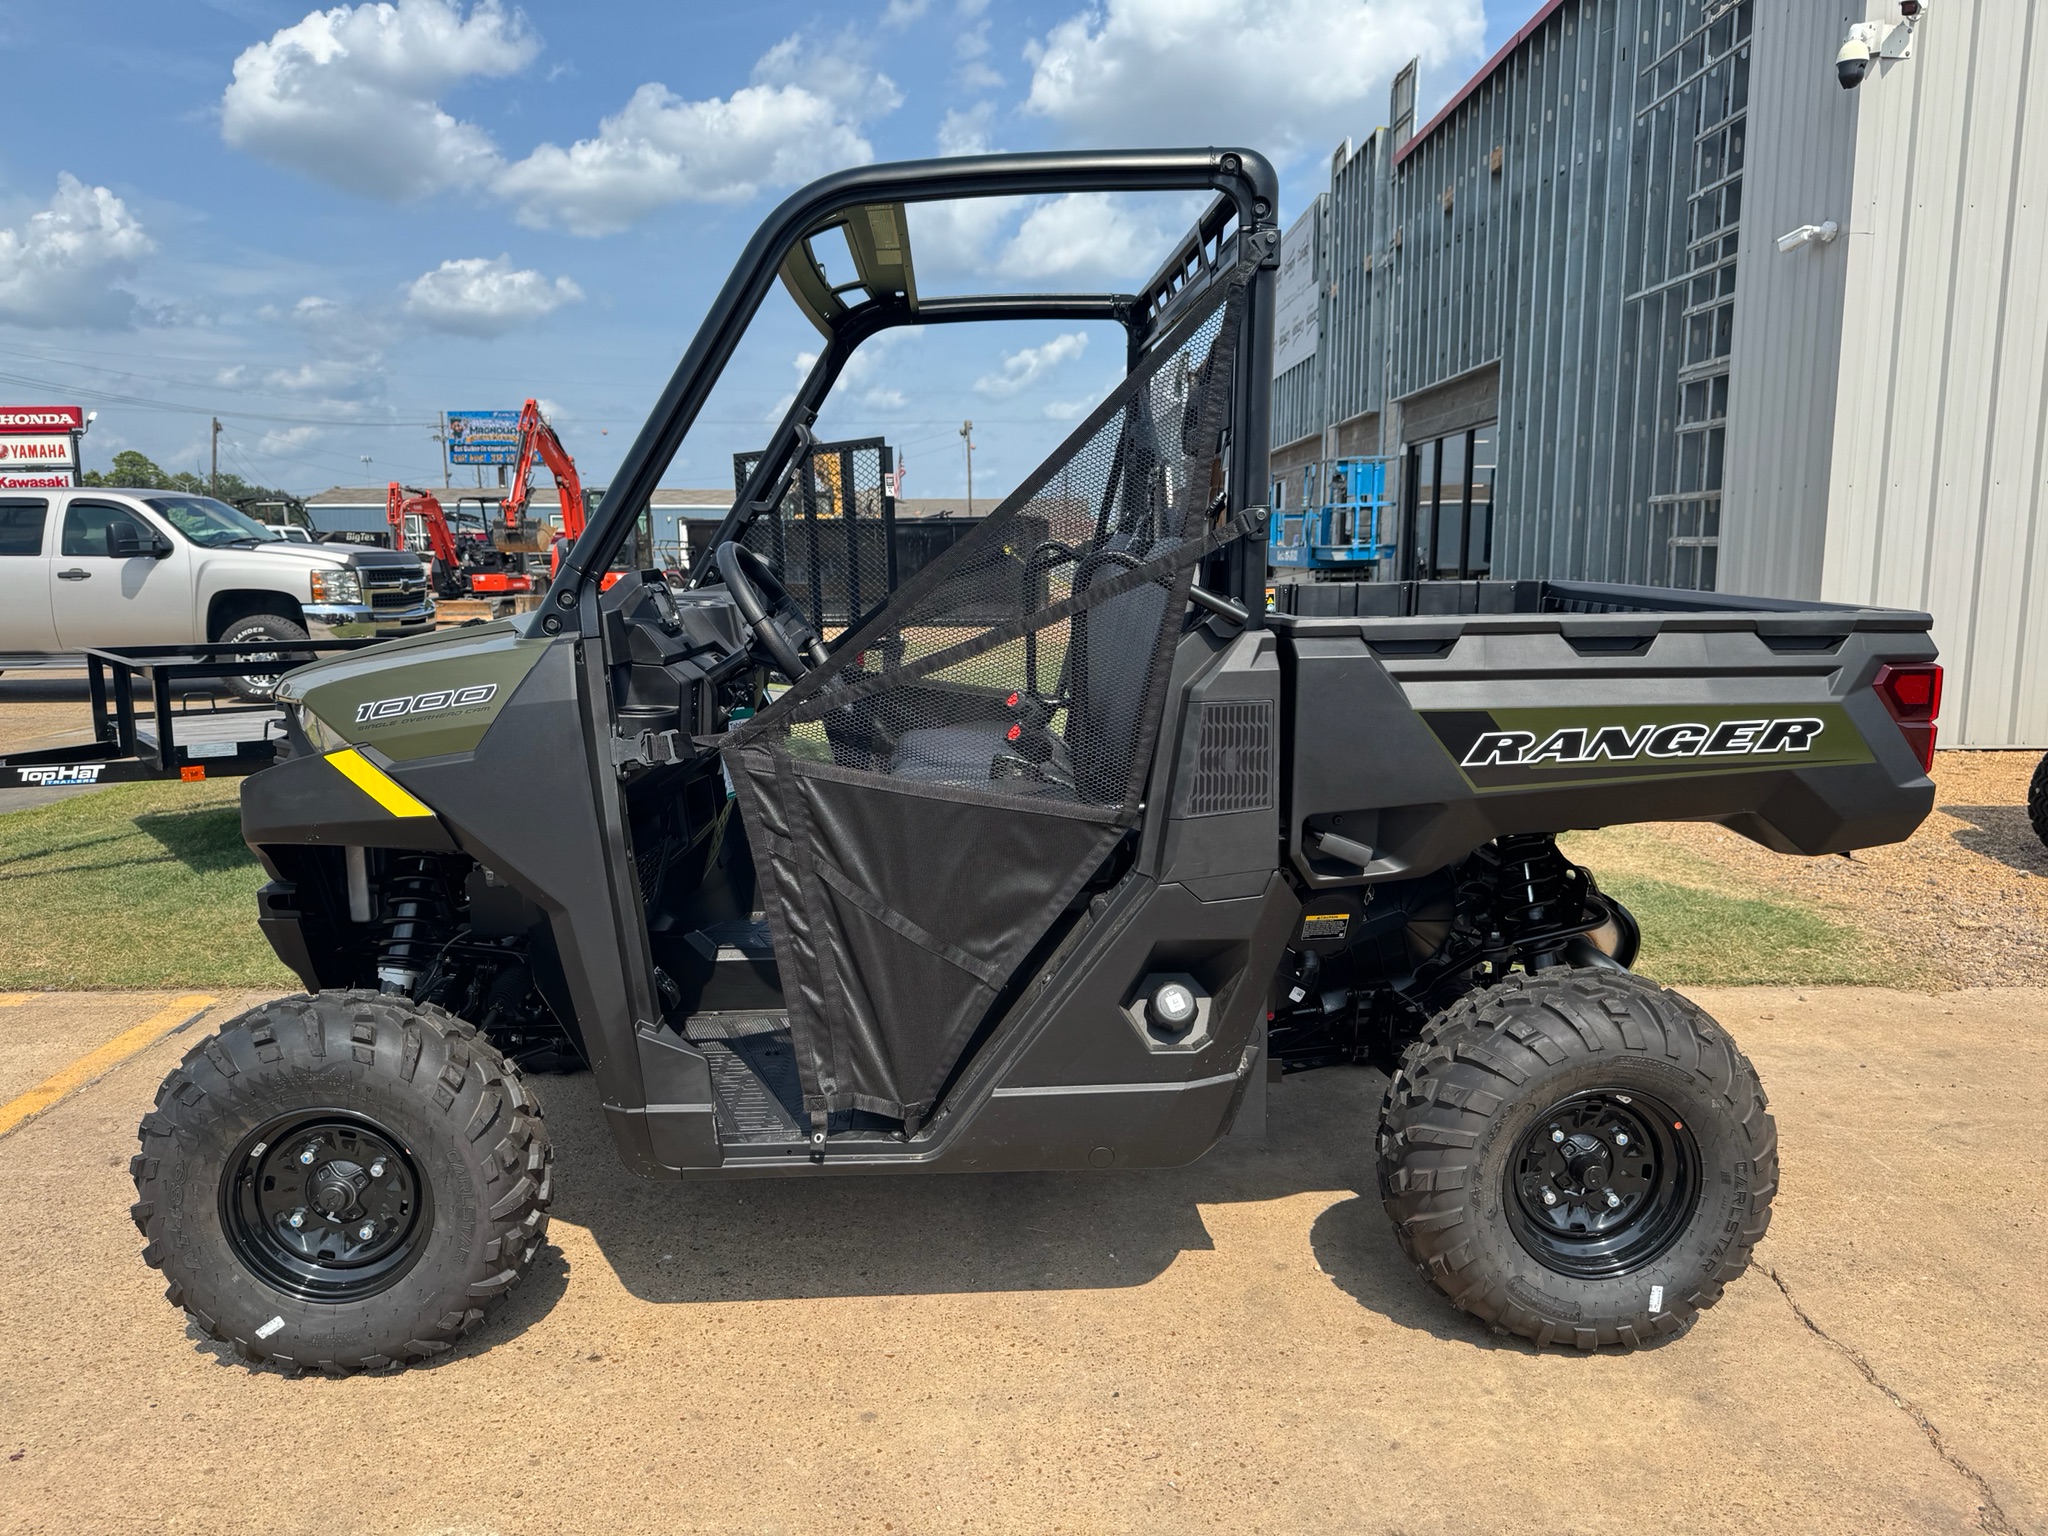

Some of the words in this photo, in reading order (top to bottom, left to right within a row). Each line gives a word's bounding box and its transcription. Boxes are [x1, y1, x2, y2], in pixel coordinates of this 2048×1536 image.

[0, 414, 76, 425] HONDA
[10, 444, 67, 458] YAMAHA
[355, 683, 499, 723] 1000
[356, 720, 398, 732] SINGLE
[401, 710, 464, 725] OVERHEAD
[464, 705, 491, 715] CAM
[1460, 717, 1825, 767] RANGER
[446, 1147, 477, 1266] CARLSTAR
[1699, 1160, 1749, 1274] CARLSTAR
